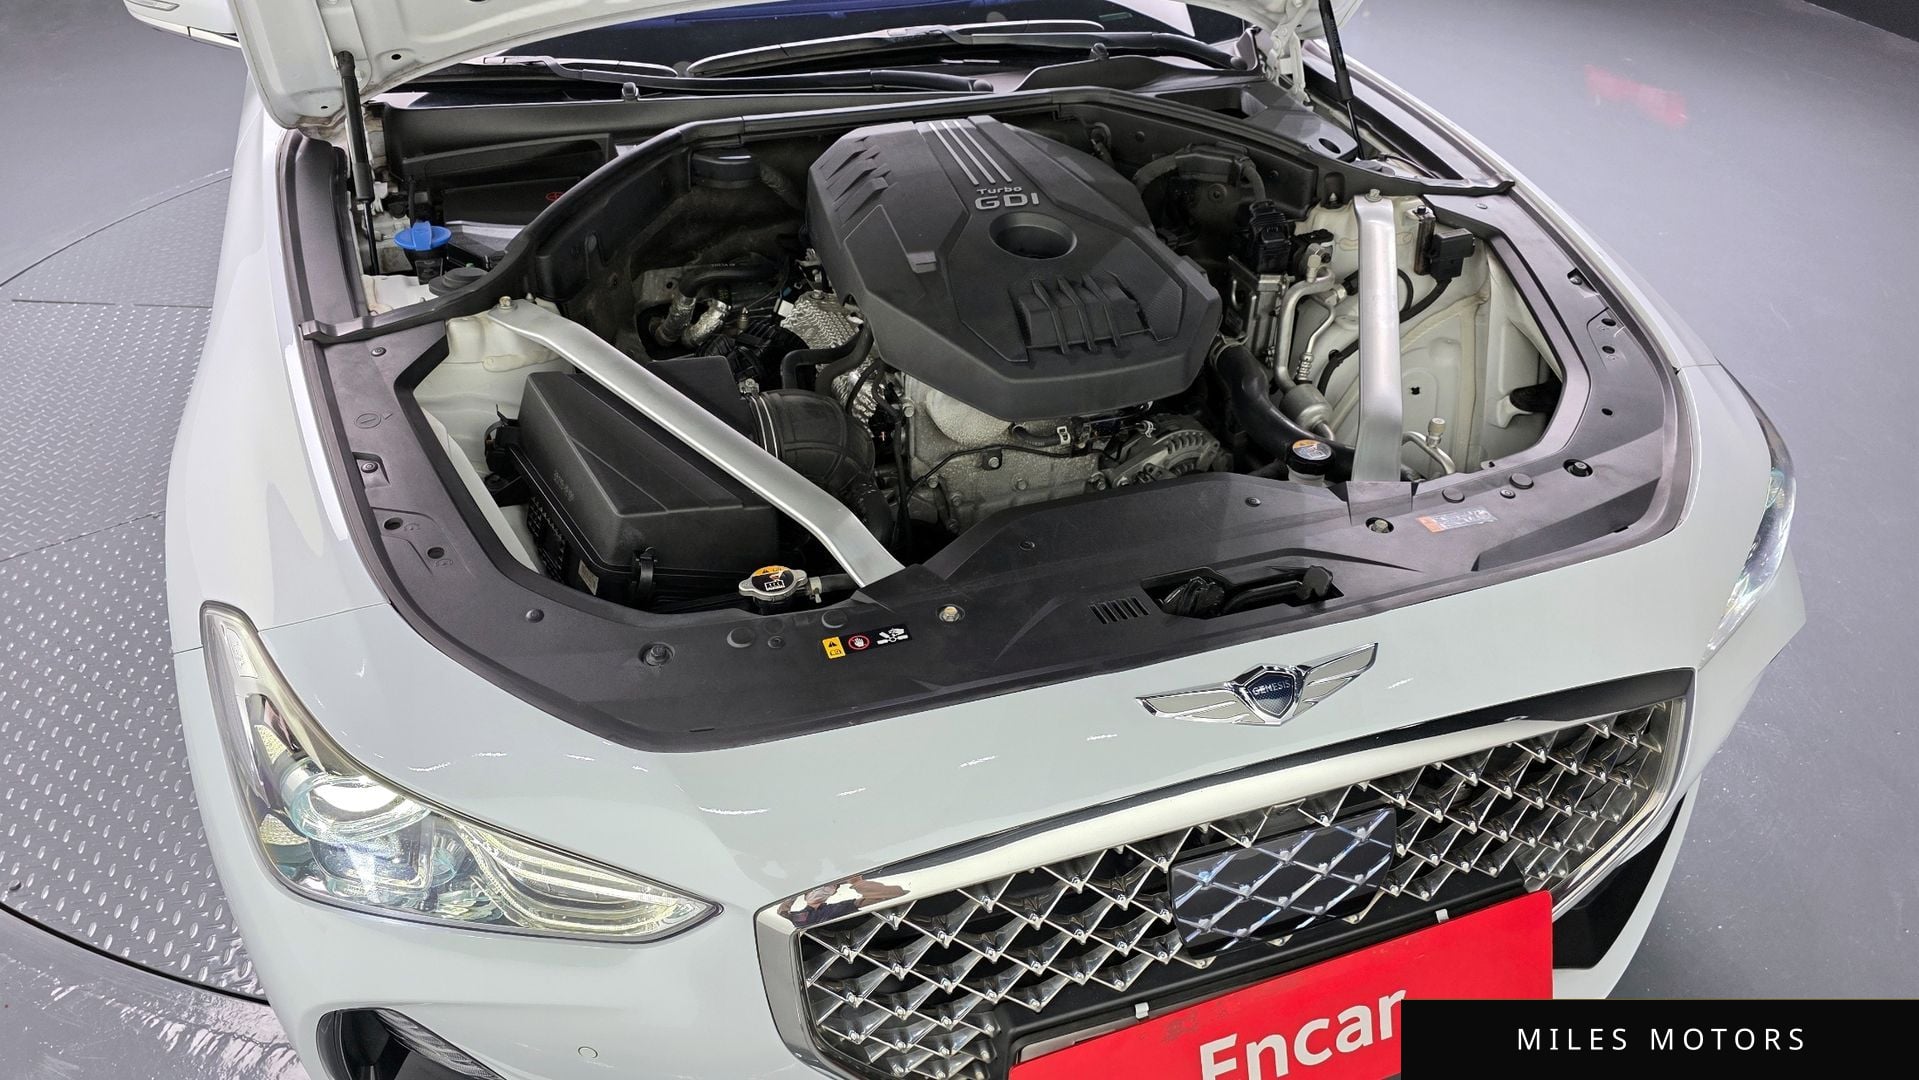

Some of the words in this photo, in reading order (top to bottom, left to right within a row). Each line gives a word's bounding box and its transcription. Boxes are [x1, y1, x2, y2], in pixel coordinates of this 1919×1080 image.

[976, 186, 1022, 195] Turbo
[1252, 680, 1291, 696] GENESIS
[1200, 990, 1406, 1080] Encar
